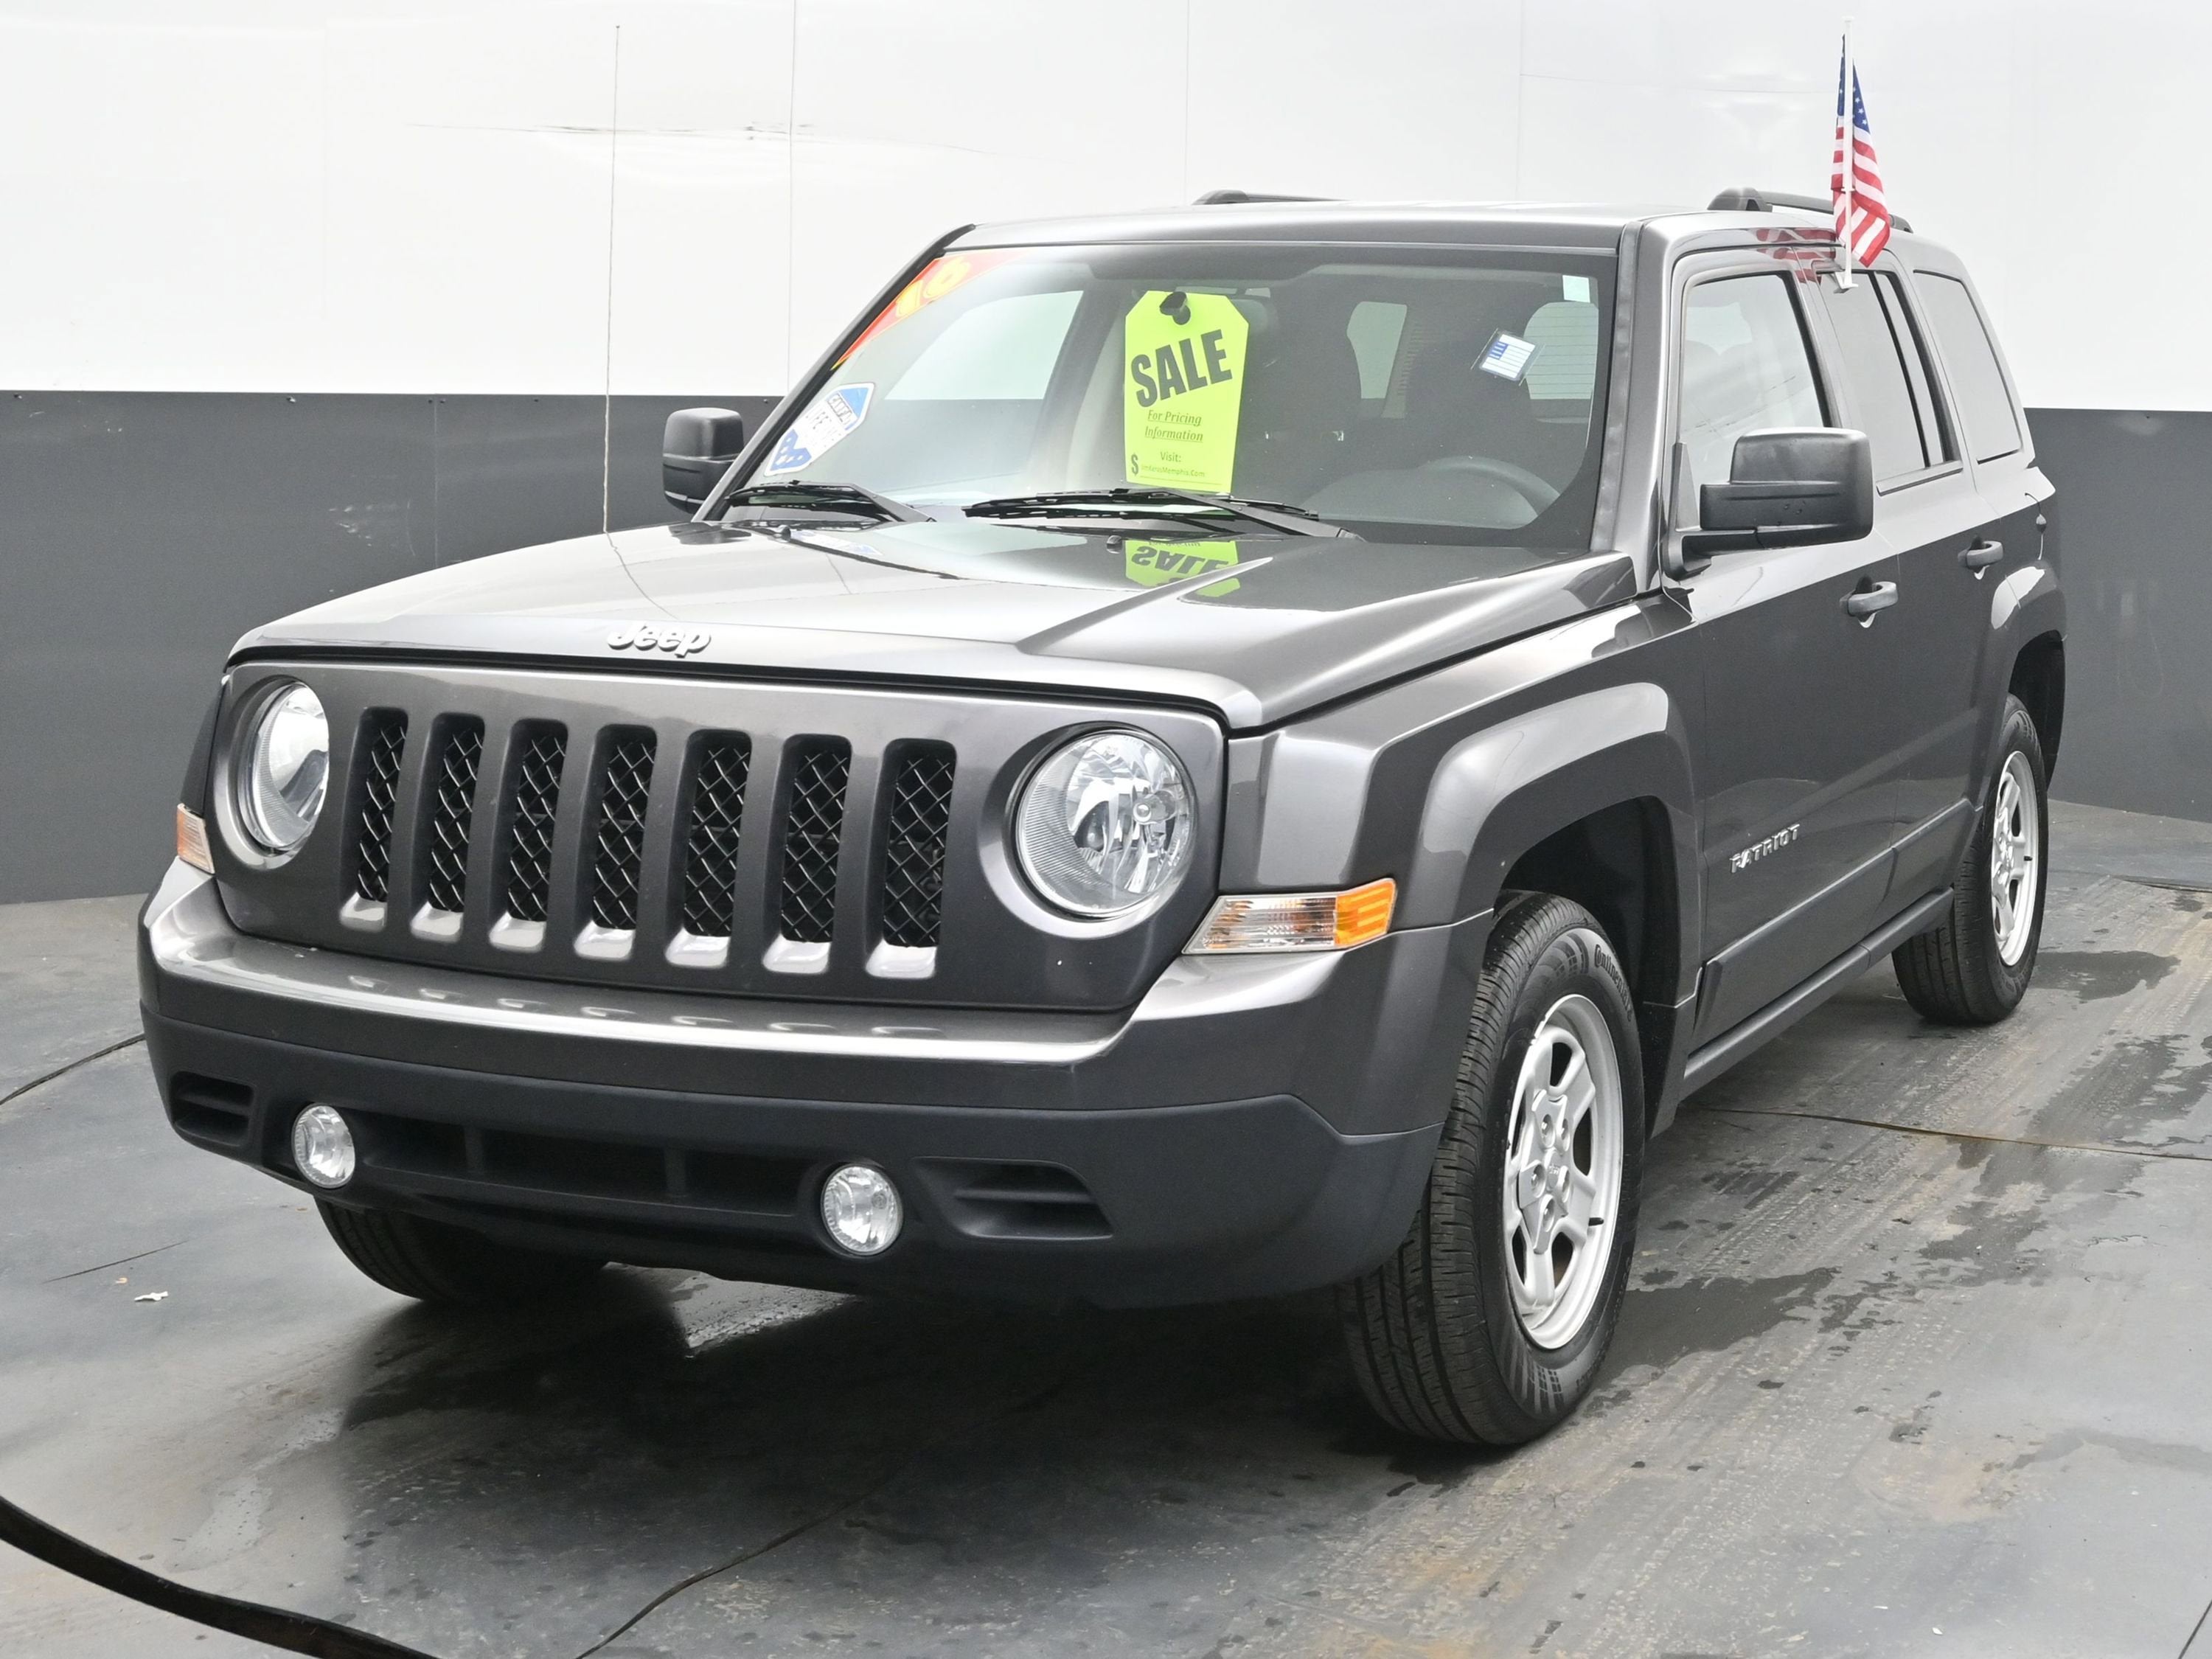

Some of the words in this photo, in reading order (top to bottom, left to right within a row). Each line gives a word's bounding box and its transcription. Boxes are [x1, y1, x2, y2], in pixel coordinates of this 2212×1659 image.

[1131, 329, 1233, 407] SALE
[1148, 409, 1163, 421] For
[1164, 411, 1202, 427] Pricing
[1144, 425, 1203, 442] Information
[1131, 452, 1139, 476] $
[1160, 451, 1182, 463] Visit:
[606, 621, 712, 659] Jeep
[1729, 823, 1801, 874] PATRIOT
